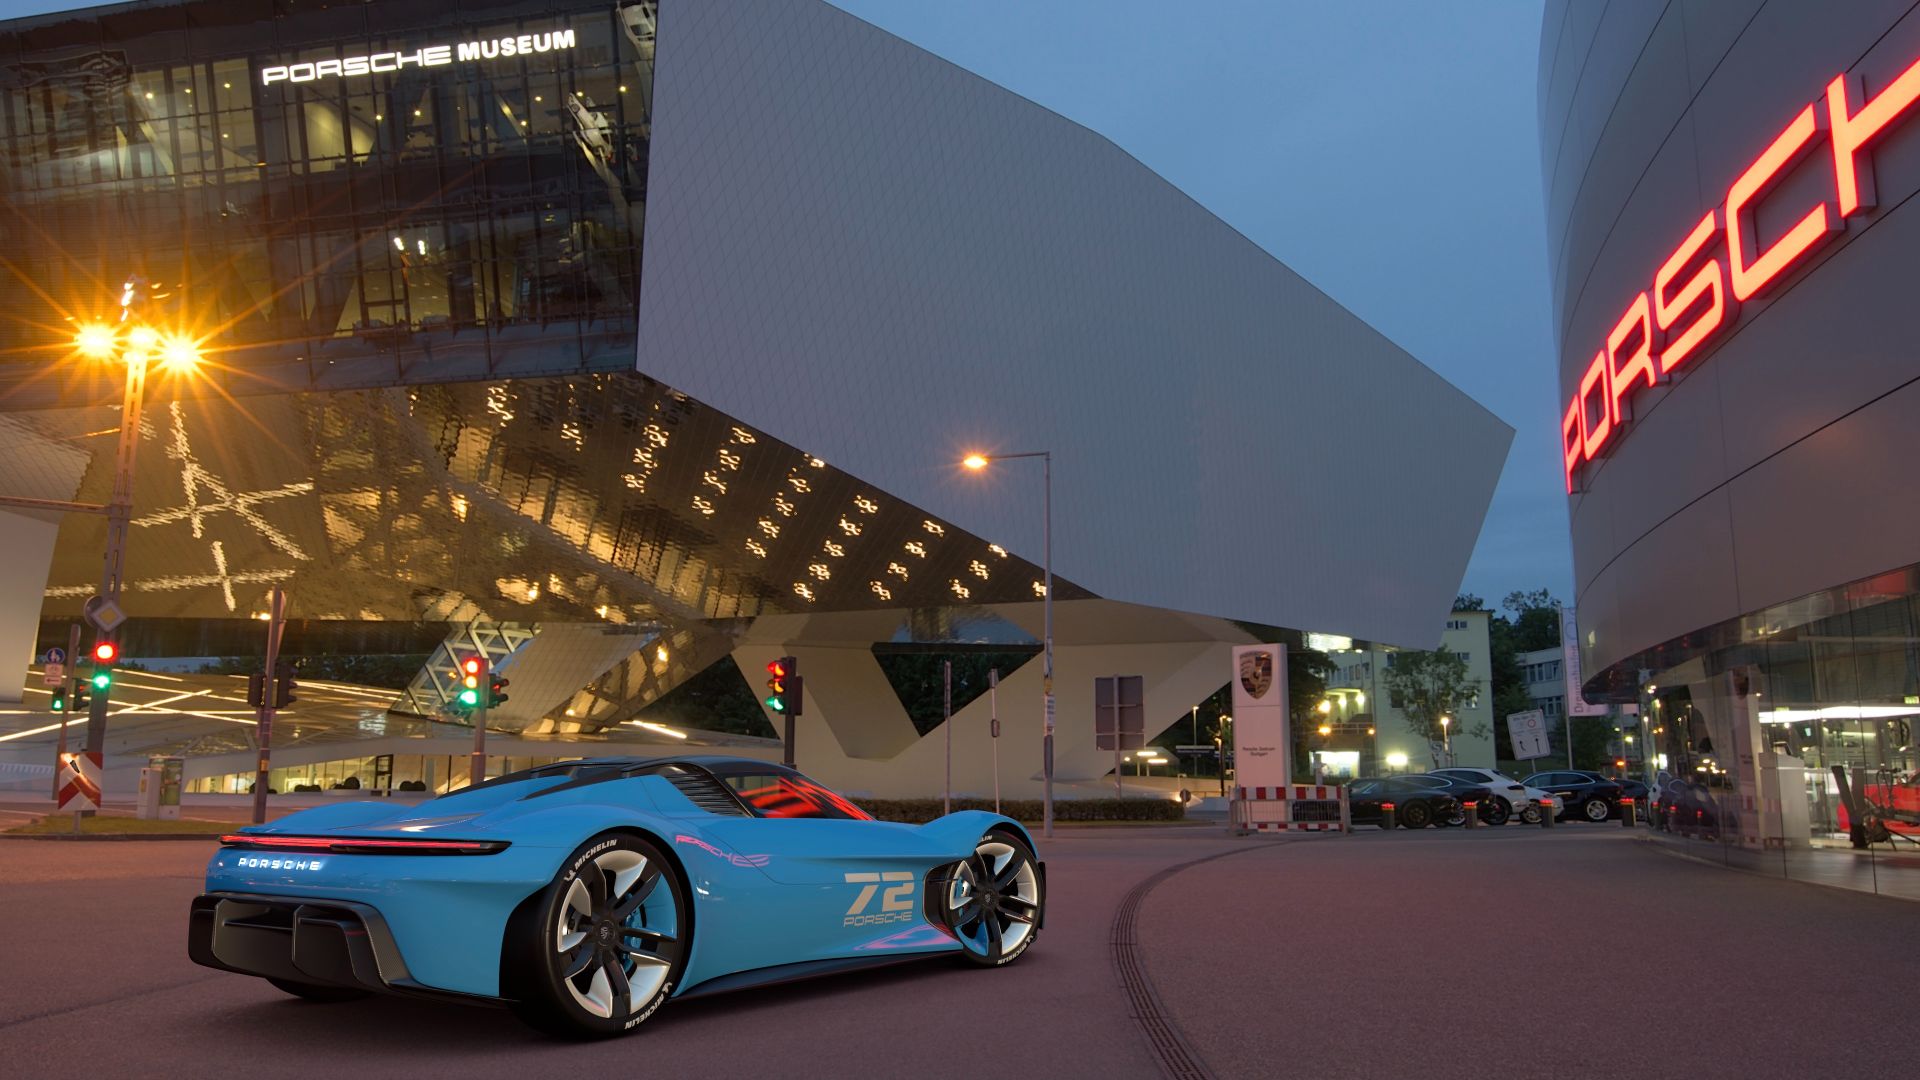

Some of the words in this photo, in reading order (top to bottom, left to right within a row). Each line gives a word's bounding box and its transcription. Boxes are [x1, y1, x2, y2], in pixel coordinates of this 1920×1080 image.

[262, 45, 452, 85] PORSCHE
[457, 29, 576, 62] MUSEUM
[238, 858, 321, 871] PORSCHE
[574, 839, 618, 870] MICHELIN
[844, 871, 915, 915] 72
[843, 911, 913, 927] PORSCHE
[624, 993, 665, 1030] MICHELIN
